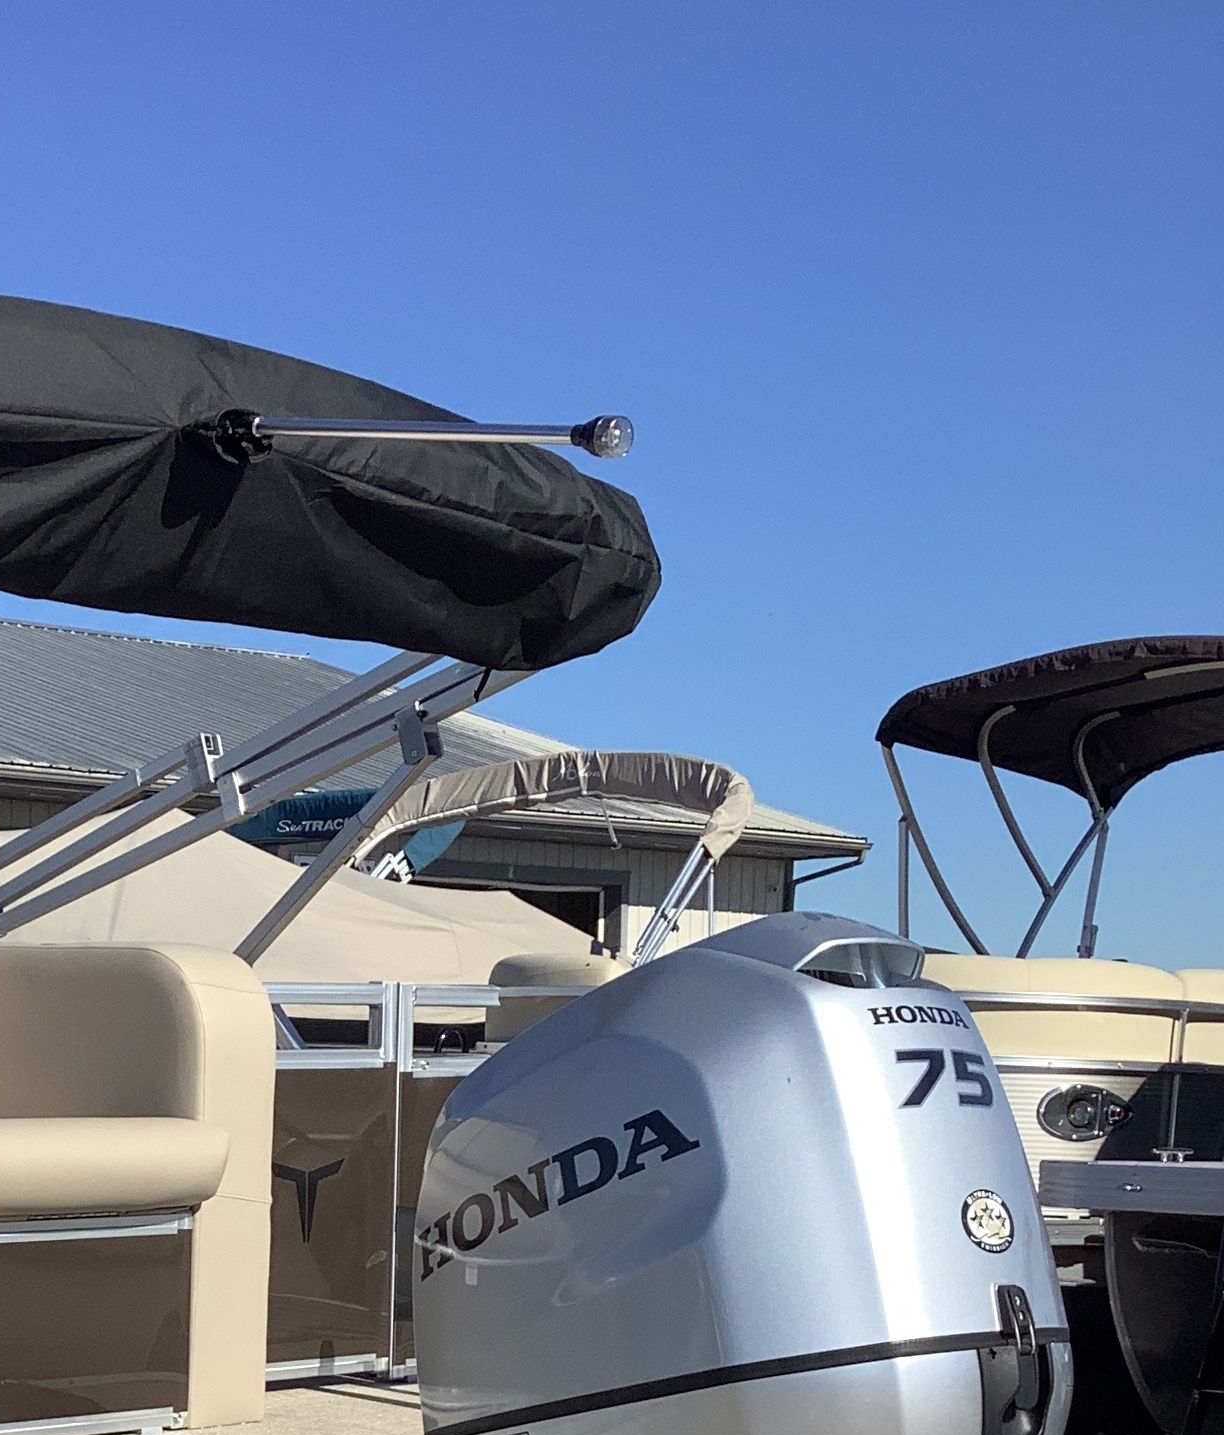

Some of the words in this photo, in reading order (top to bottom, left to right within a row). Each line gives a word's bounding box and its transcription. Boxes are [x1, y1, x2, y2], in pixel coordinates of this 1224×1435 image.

[276, 818, 349, 833] SunTRAC
[867, 1005, 970, 1030] HONDA
[894, 1048, 993, 1108] 75
[417, 1109, 701, 1282] HONDA
